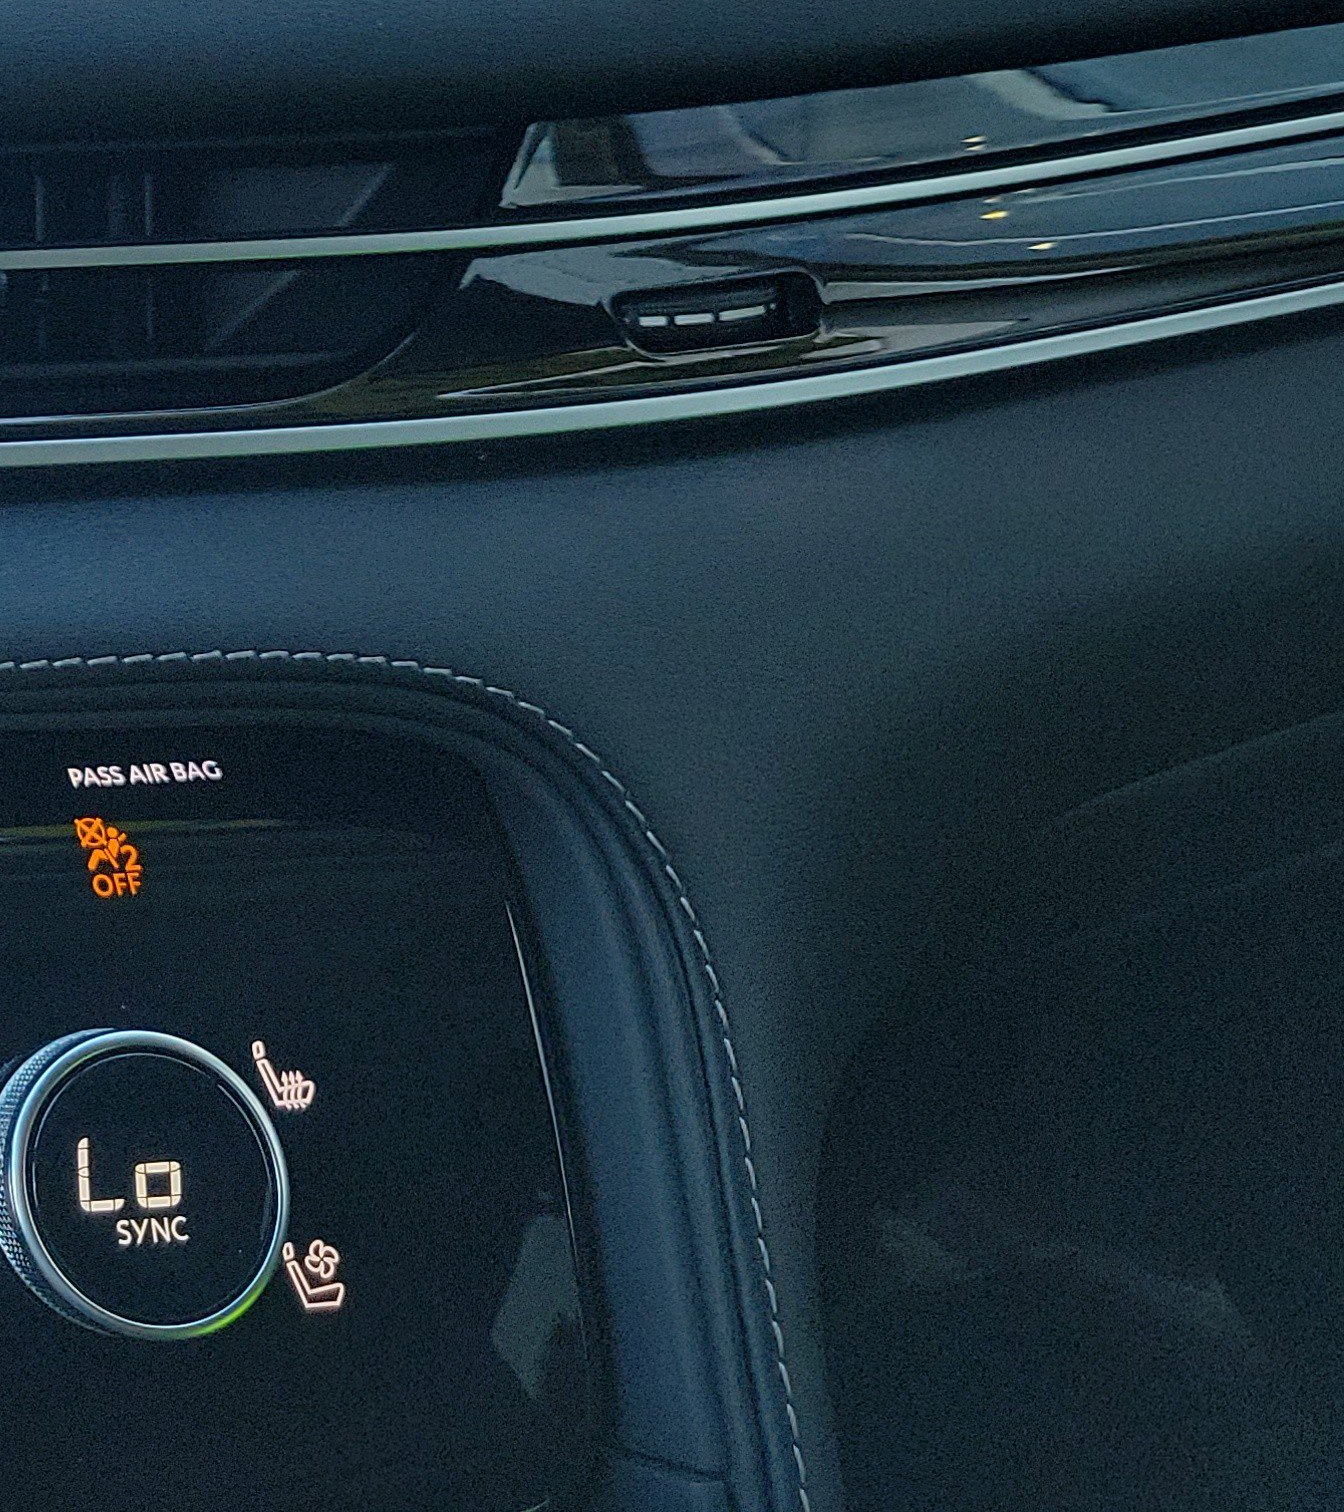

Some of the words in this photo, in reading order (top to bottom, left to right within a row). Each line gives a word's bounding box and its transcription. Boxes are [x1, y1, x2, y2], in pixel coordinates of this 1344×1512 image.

[66, 765, 127, 788] PASS
[129, 762, 171, 785] AIR
[169, 759, 223, 782] BAG
[92, 871, 142, 898] OFF
[77, 1136, 183, 1213] Lo
[115, 1215, 190, 1246] SYNC
